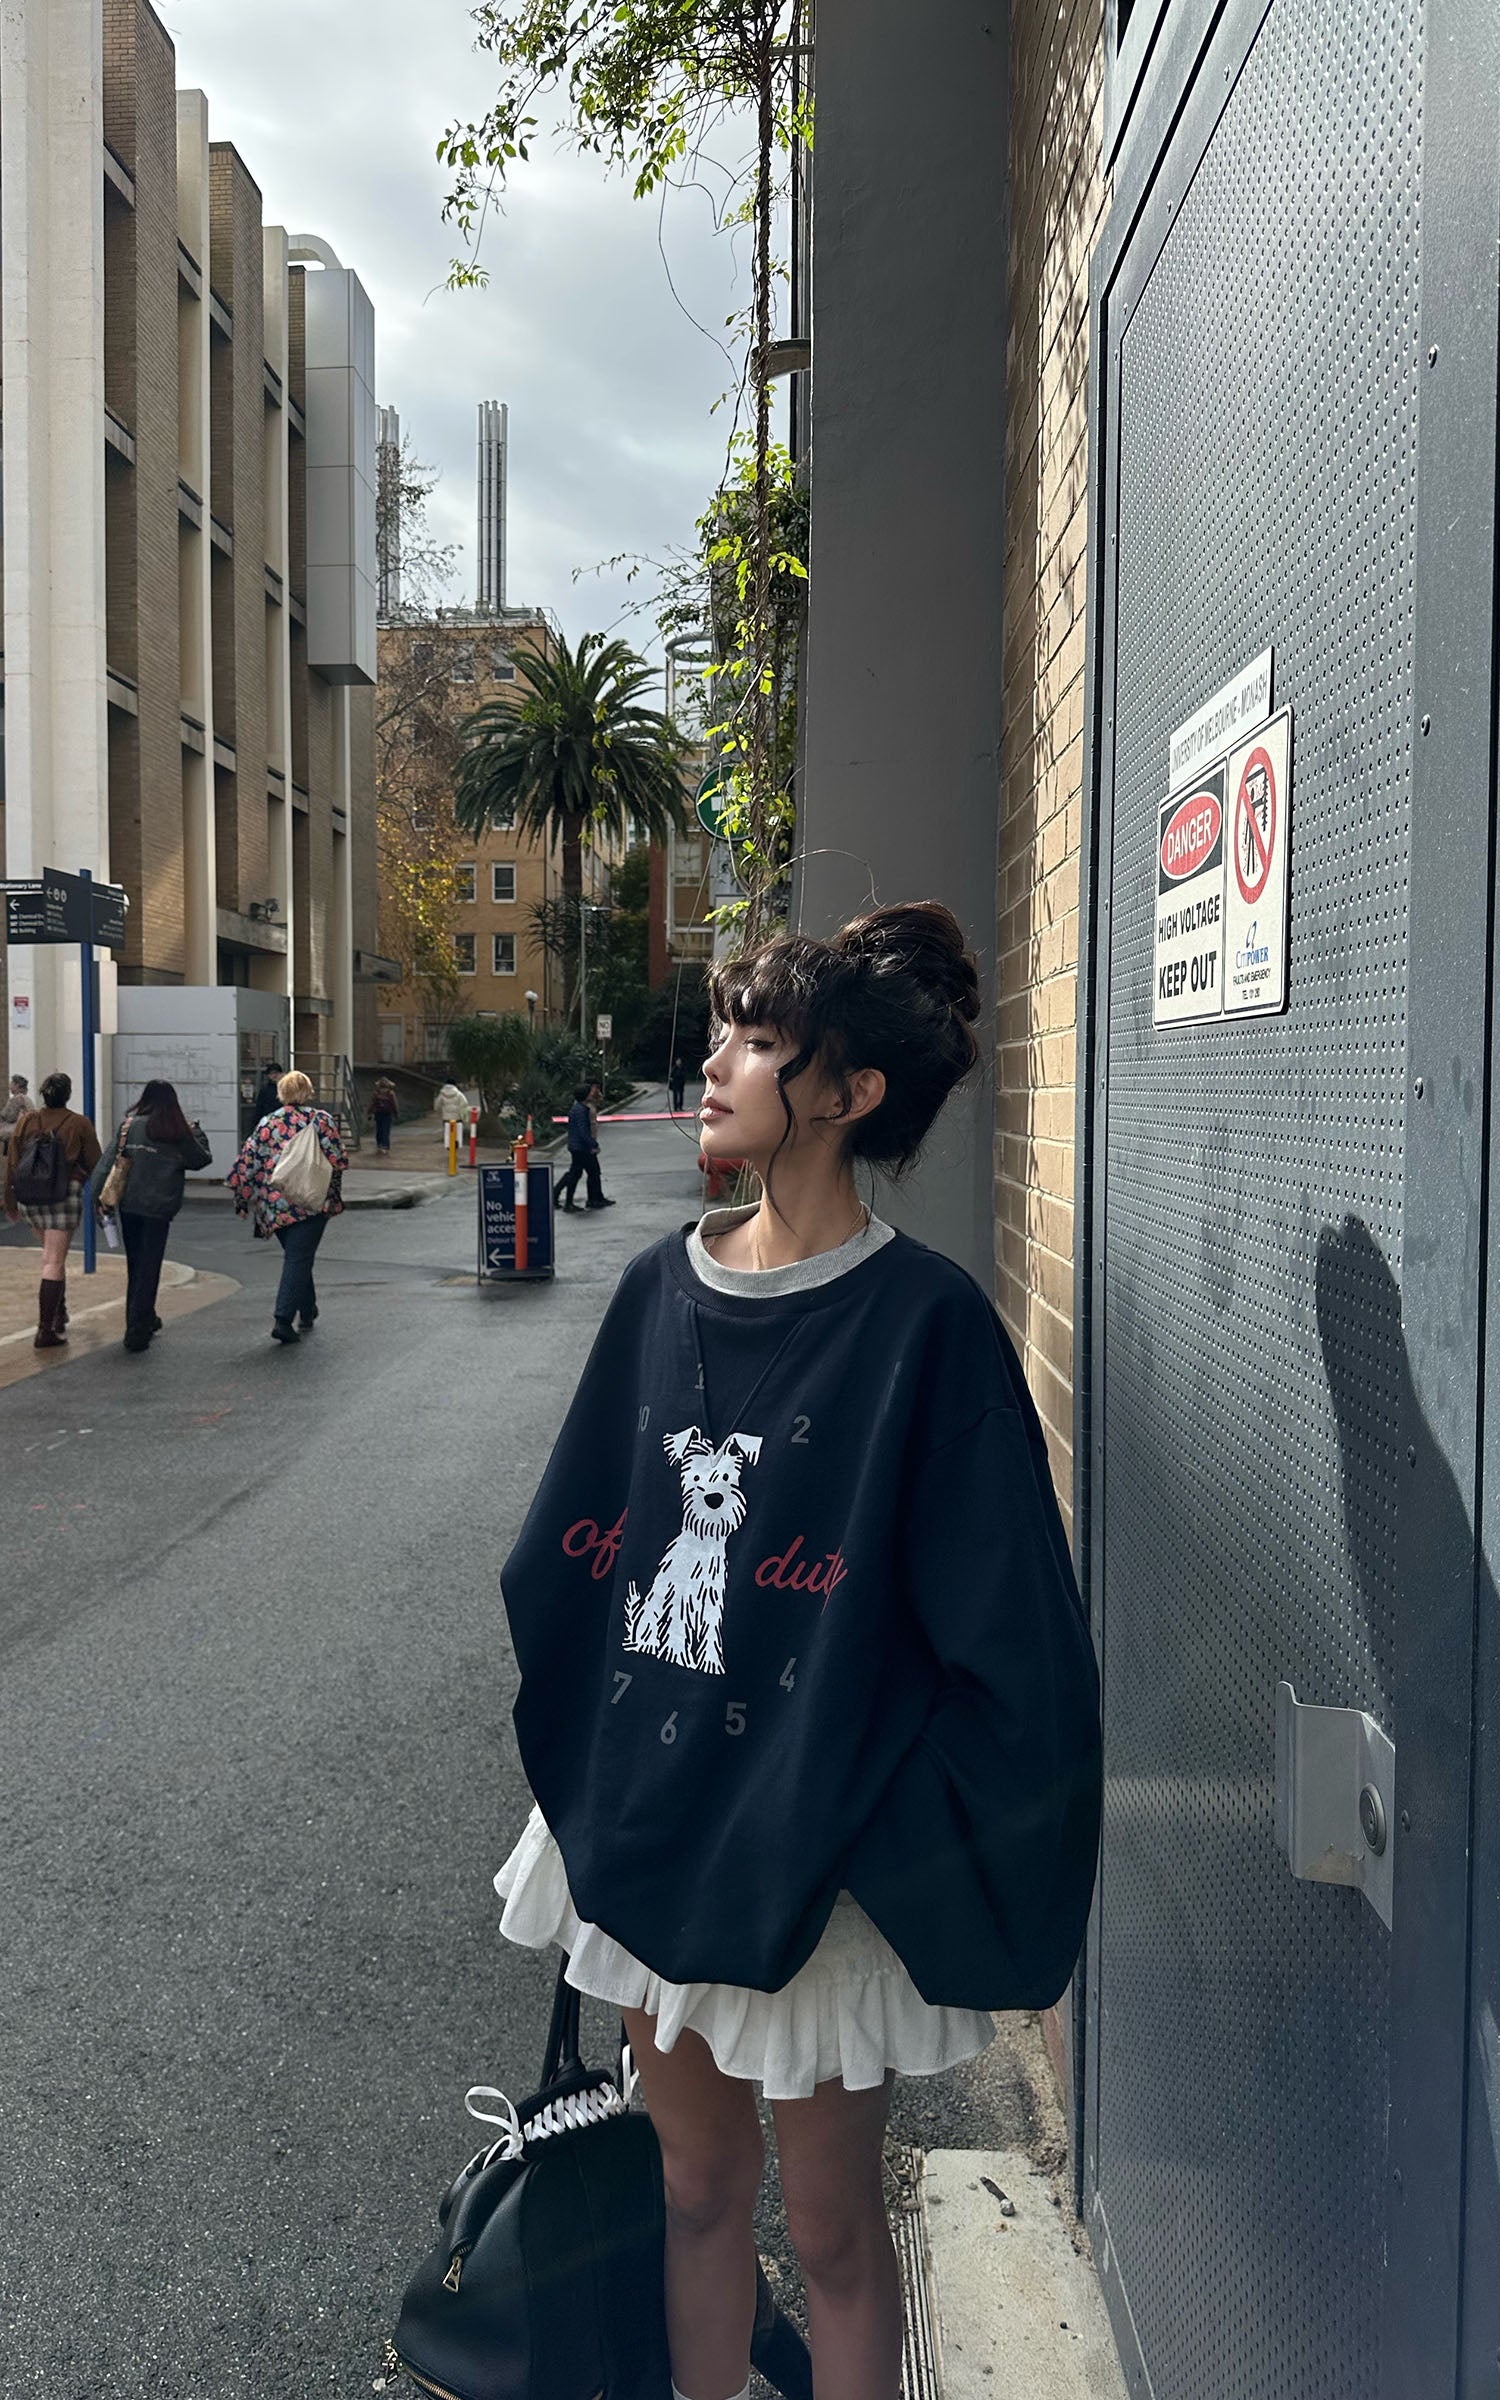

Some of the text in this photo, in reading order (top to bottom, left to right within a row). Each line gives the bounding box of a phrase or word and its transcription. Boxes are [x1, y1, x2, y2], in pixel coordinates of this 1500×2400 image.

[1167, 807, 1213, 865] DANGER
[1158, 893, 1221, 944] HIGH VOLTAGE
[1158, 951, 1217, 1000] KEEP OUT
[486, 1200, 503, 1211] No
[486, 1211, 516, 1223] vehic
[487, 1224, 516, 1234] acces
[791, 1415, 811, 1444] 2
[562, 1506, 628, 1580] of
[611, 1670, 633, 1705] 7
[779, 1657, 797, 1693] 4
[660, 1710, 679, 1745] 6
[724, 1702, 747, 1736] 5
